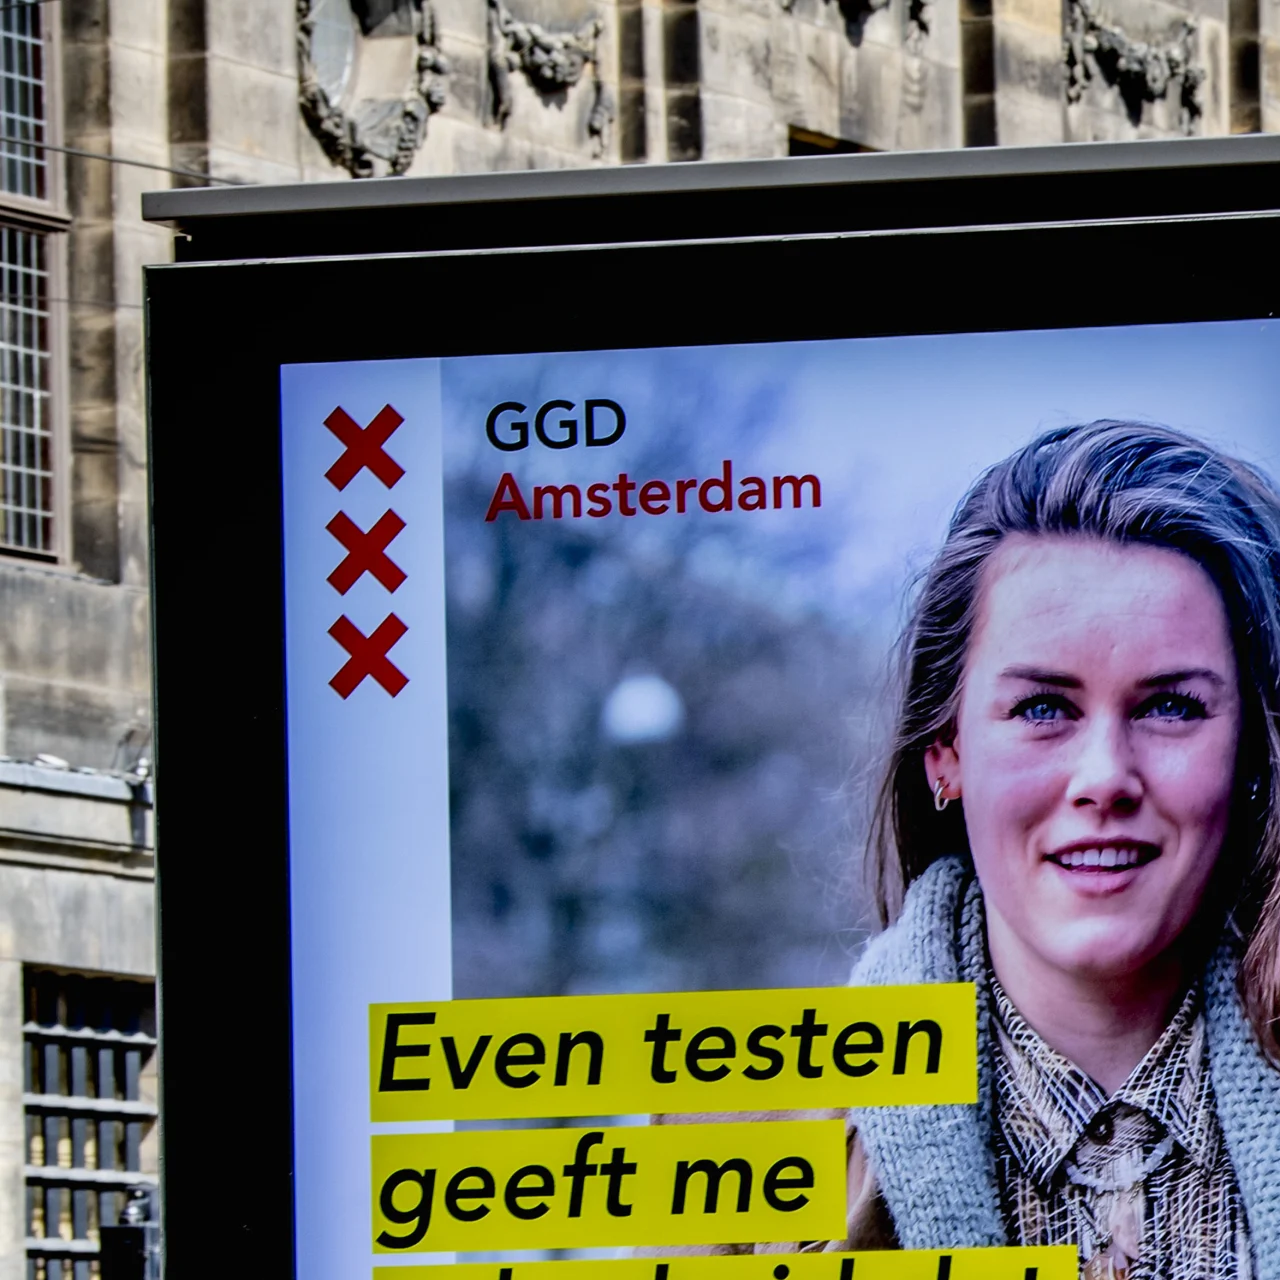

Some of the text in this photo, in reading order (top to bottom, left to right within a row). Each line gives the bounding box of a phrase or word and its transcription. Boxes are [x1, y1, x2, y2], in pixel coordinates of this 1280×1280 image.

[485, 398, 627, 452] GGD
[484, 459, 822, 523] Amsterdam
[377, 1007, 944, 1094] Even testen
[375, 1131, 816, 1249] geeft me
